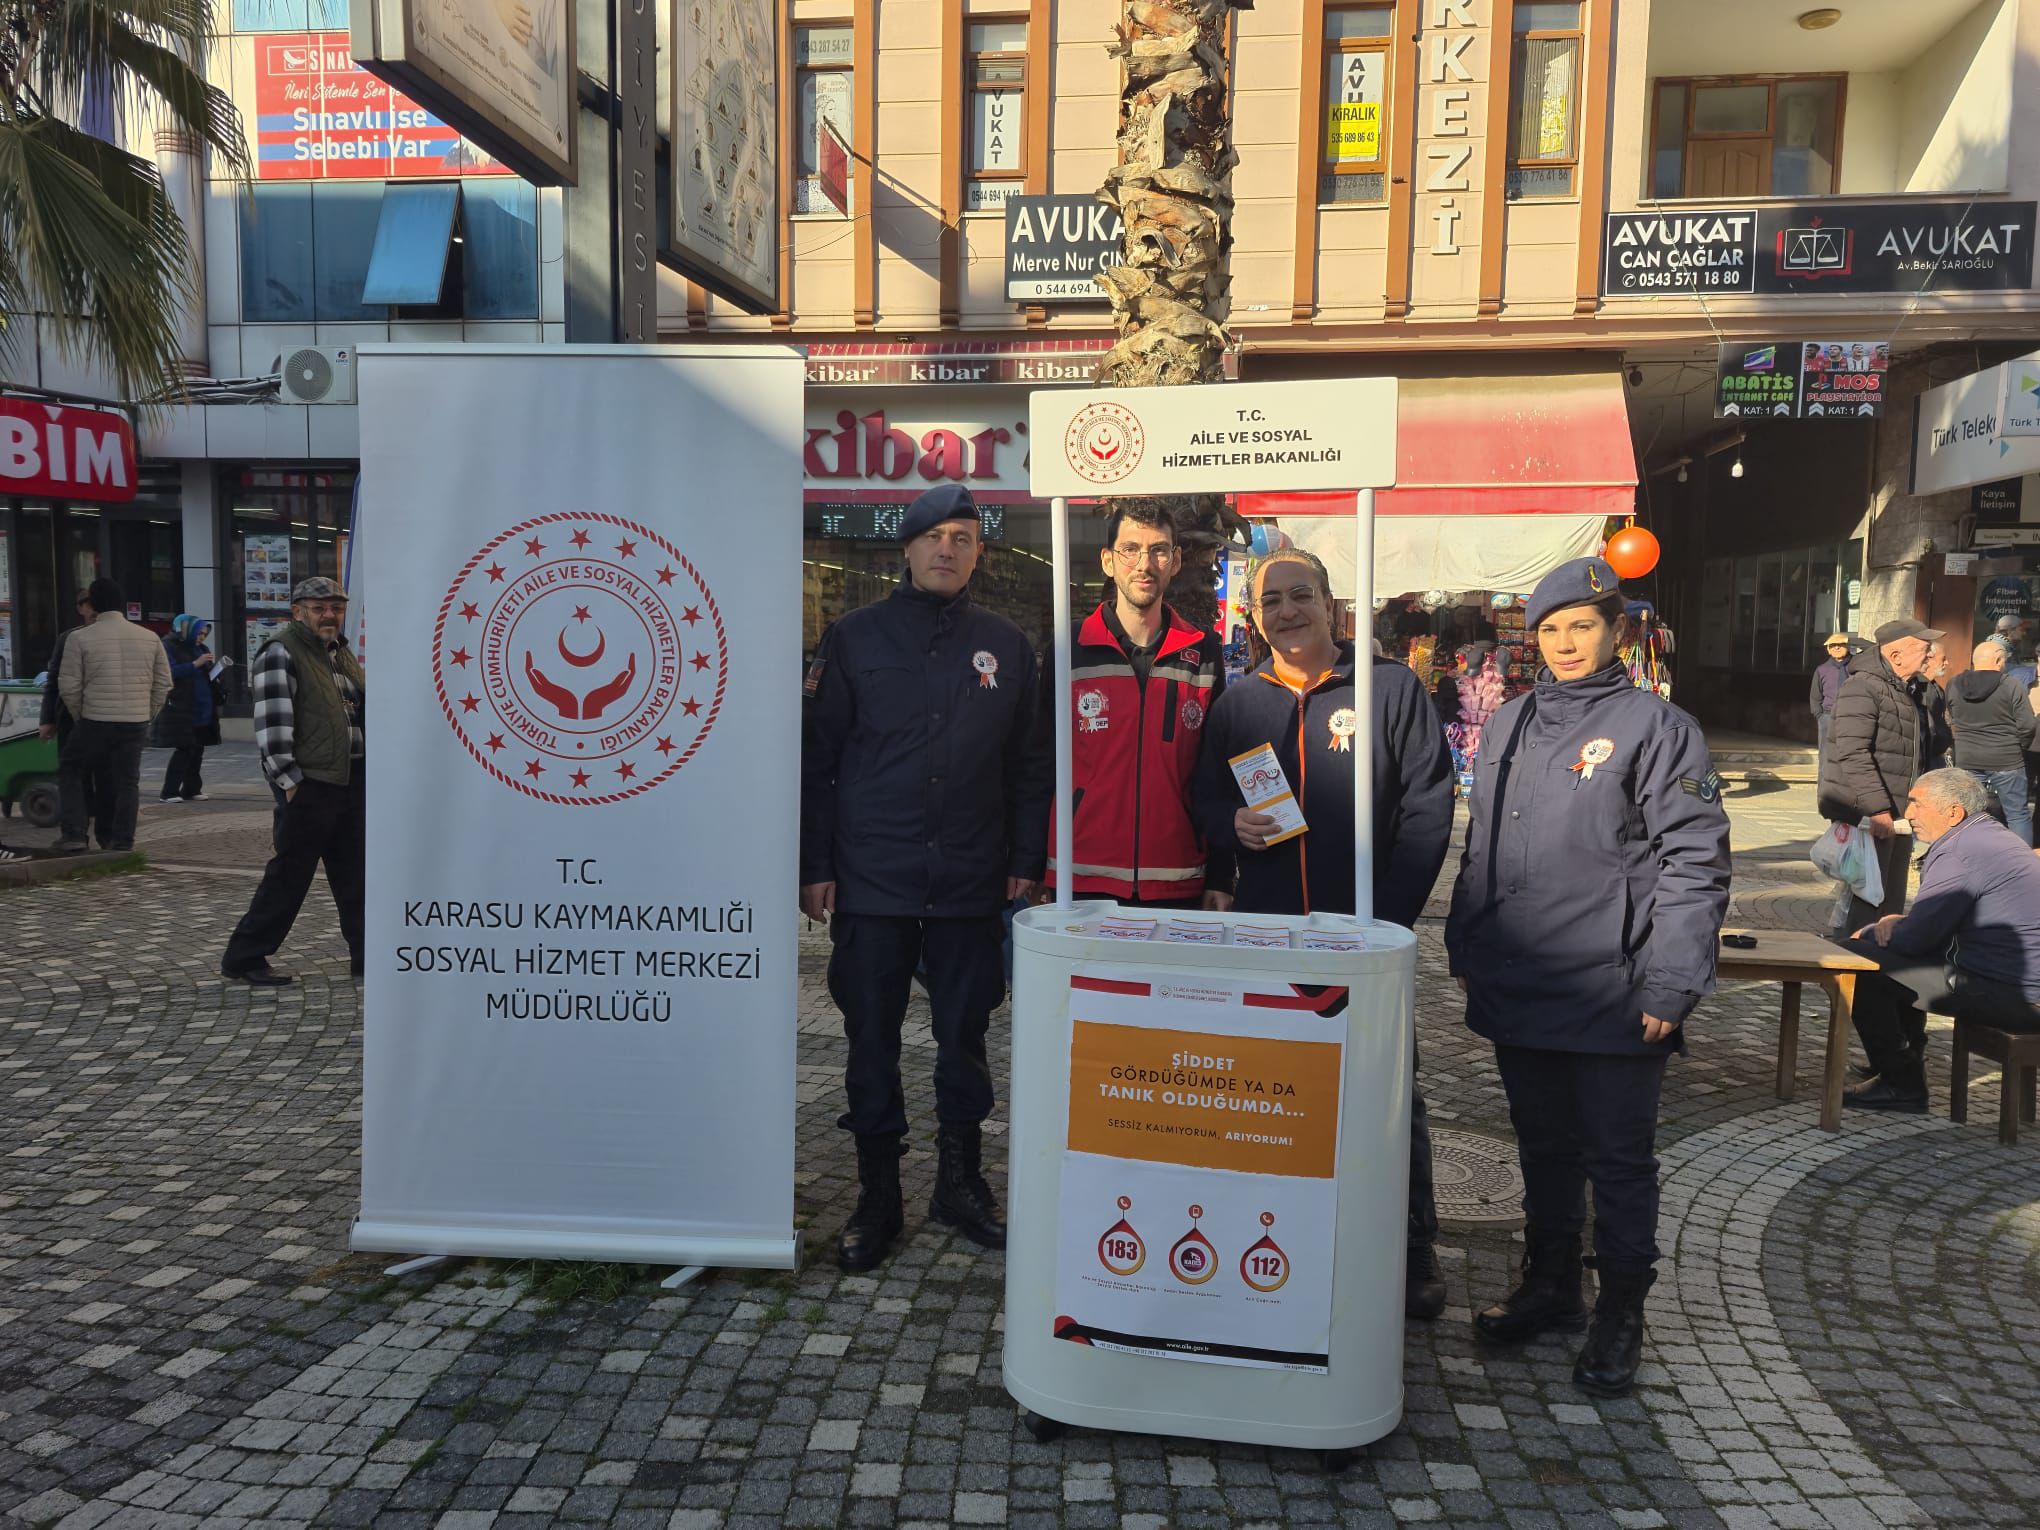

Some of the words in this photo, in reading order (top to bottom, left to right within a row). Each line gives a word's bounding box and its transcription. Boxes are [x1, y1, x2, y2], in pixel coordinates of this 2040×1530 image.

[818, 40, 830, 54] 287
[832, 40, 841, 53] 54
[842, 39, 850, 52] 27
[363, 81, 386, 99] Sen
[293, 105, 381, 131] Sınavlı
[294, 135, 380, 160] Sebebi
[386, 134, 431, 158] Var
[1331, 132, 1343, 143] 535
[1344, 132, 1356, 143] 689
[1367, 131, 1375, 142] 43
[1530, 170, 1545, 182] 776
[1557, 169, 1568, 181] 86
[972, 189, 987, 202] 0544
[989, 189, 1001, 201] 694
[1612, 217, 1750, 247] AVUKAT
[1876, 224, 2020, 256] AVUKAT
[1012, 252, 1060, 272] Merve
[1065, 251, 1094, 271] Nur
[1620, 250, 1661, 269] CAN
[1667, 245, 1744, 273] ÇAĞLAR
[1941, 256, 1994, 269] SARIOĞLU
[1035, 283, 1043, 295] 0
[1046, 283, 1066, 295] 544
[1070, 282, 1091, 294] 694
[1639, 272, 1671, 287] 0543
[1674, 271, 1697, 286] 571
[1705, 271, 1719, 285] 18
[1723, 270, 1740, 284] 80
[910, 364, 984, 381] kibar
[1018, 362, 1097, 380] kibar
[1722, 373, 1794, 390] ABATİS
[1833, 374, 1880, 391] MOS
[1236, 408, 1266, 423] T.C.
[1743, 406, 1763, 415] KAT:
[1765, 406, 1770, 415] 1
[1828, 406, 1848, 415] KAT:
[1850, 406, 1855, 415] 1
[2010, 417, 2032, 428] Türk
[0, 405, 128, 488] BİM
[1190, 430, 1225, 446] AİLE
[1228, 431, 1249, 445] VE
[1251, 429, 1313, 443] SOSYAL
[1933, 424, 1958, 449] Türk
[1162, 451, 1251, 468] HİZMETLER
[1254, 447, 1342, 466] BAKANLIĞI
[1981, 490, 2006, 500] Kaya
[558, 564, 580, 580] VE
[524, 569, 557, 597] AİLE
[583, 565, 642, 601] SOSYAL
[487, 588, 525, 699] CUMHURİYETİ
[639, 594, 675, 685] HİZMETLER
[501, 698, 557, 750] TÜRKİYE
[600, 688, 670, 751] BAKANLIĞI
[556, 858, 604, 885] T.C.
[404, 901, 524, 929] KARASU
[396, 946, 506, 974] SOSYAL
[515, 943, 626, 976] HİZMET
[635, 947, 761, 980] MERKEZİ
[486, 988, 672, 1022] MÜDÜRLÜĞÜ
[1171, 1050, 1236, 1072] ŞİDDET
[1110, 1065, 1237, 1091] GÖRDÜĞÜMDE
[1244, 1079, 1265, 1094] YA
[1272, 1083, 1296, 1097] DA
[1099, 1083, 1155, 1103] TANIK
[1161, 1092, 1306, 1118] OLDUĞUMDA...
[1107, 1117, 1142, 1131] SESSİZ
[1225, 1131, 1293, 1146] ARIYORUM!
[1106, 1239, 1138, 1261] 183
[1251, 1256, 1280, 1277] 112
